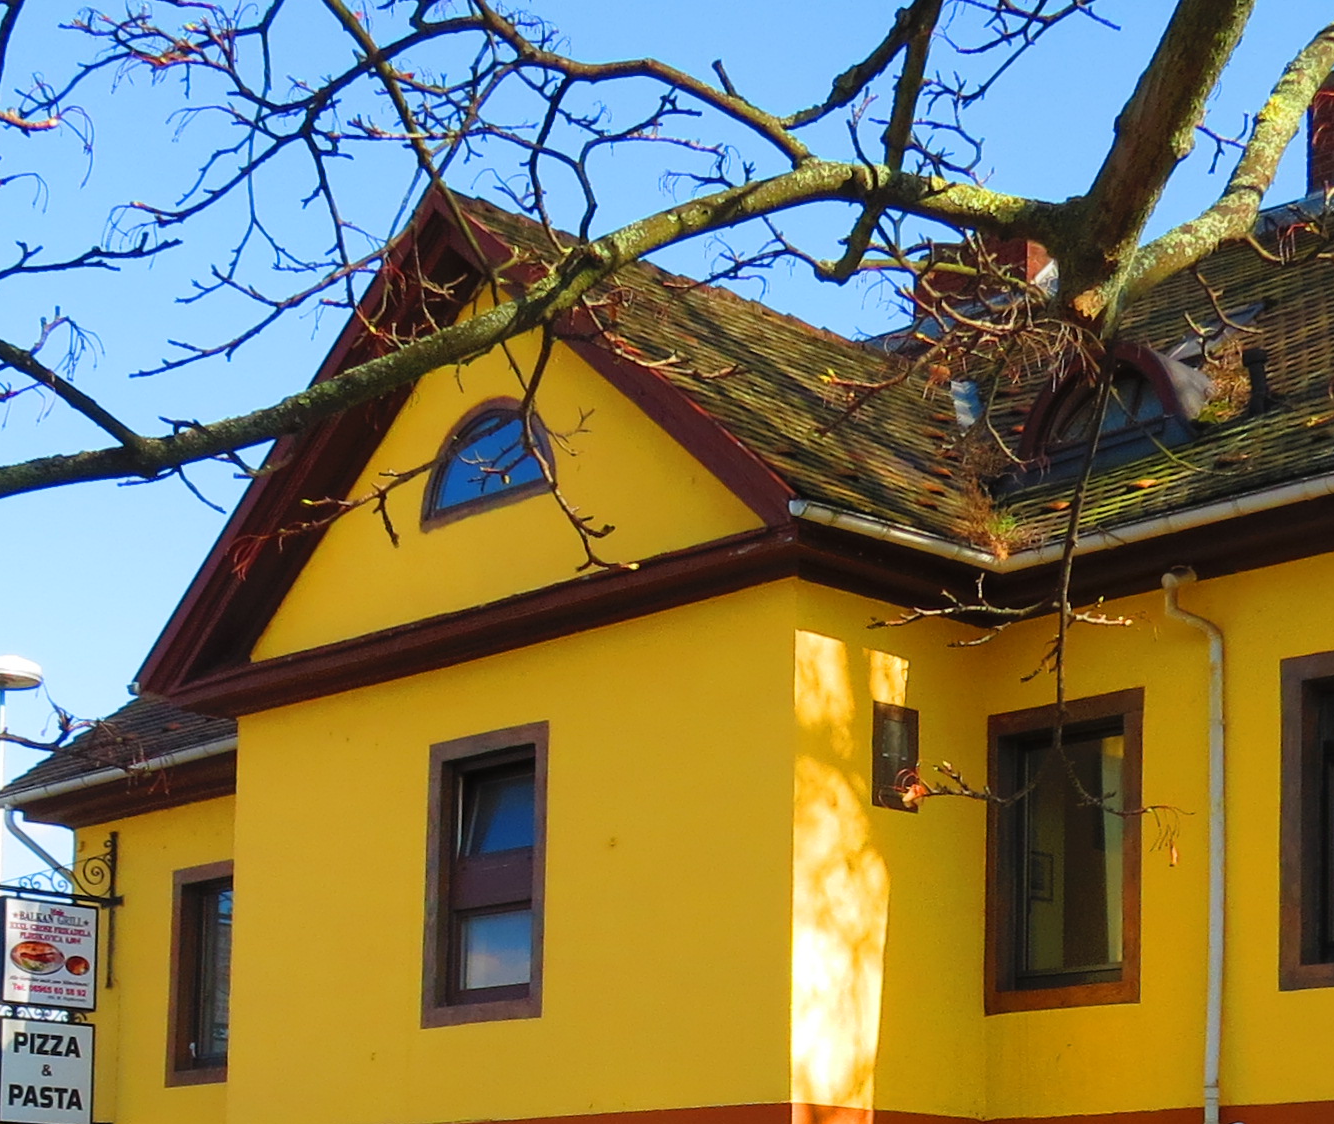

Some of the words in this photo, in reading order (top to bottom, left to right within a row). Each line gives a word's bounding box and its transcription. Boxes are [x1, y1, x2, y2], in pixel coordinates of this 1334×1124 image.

[19, 911, 53, 923] BALKAN
[57, 915, 83, 926] GRILL
[13, 1032, 81, 1058] PIZZA
[41, 1064, 52, 1077] &
[8, 1084, 83, 1111] PASTA
